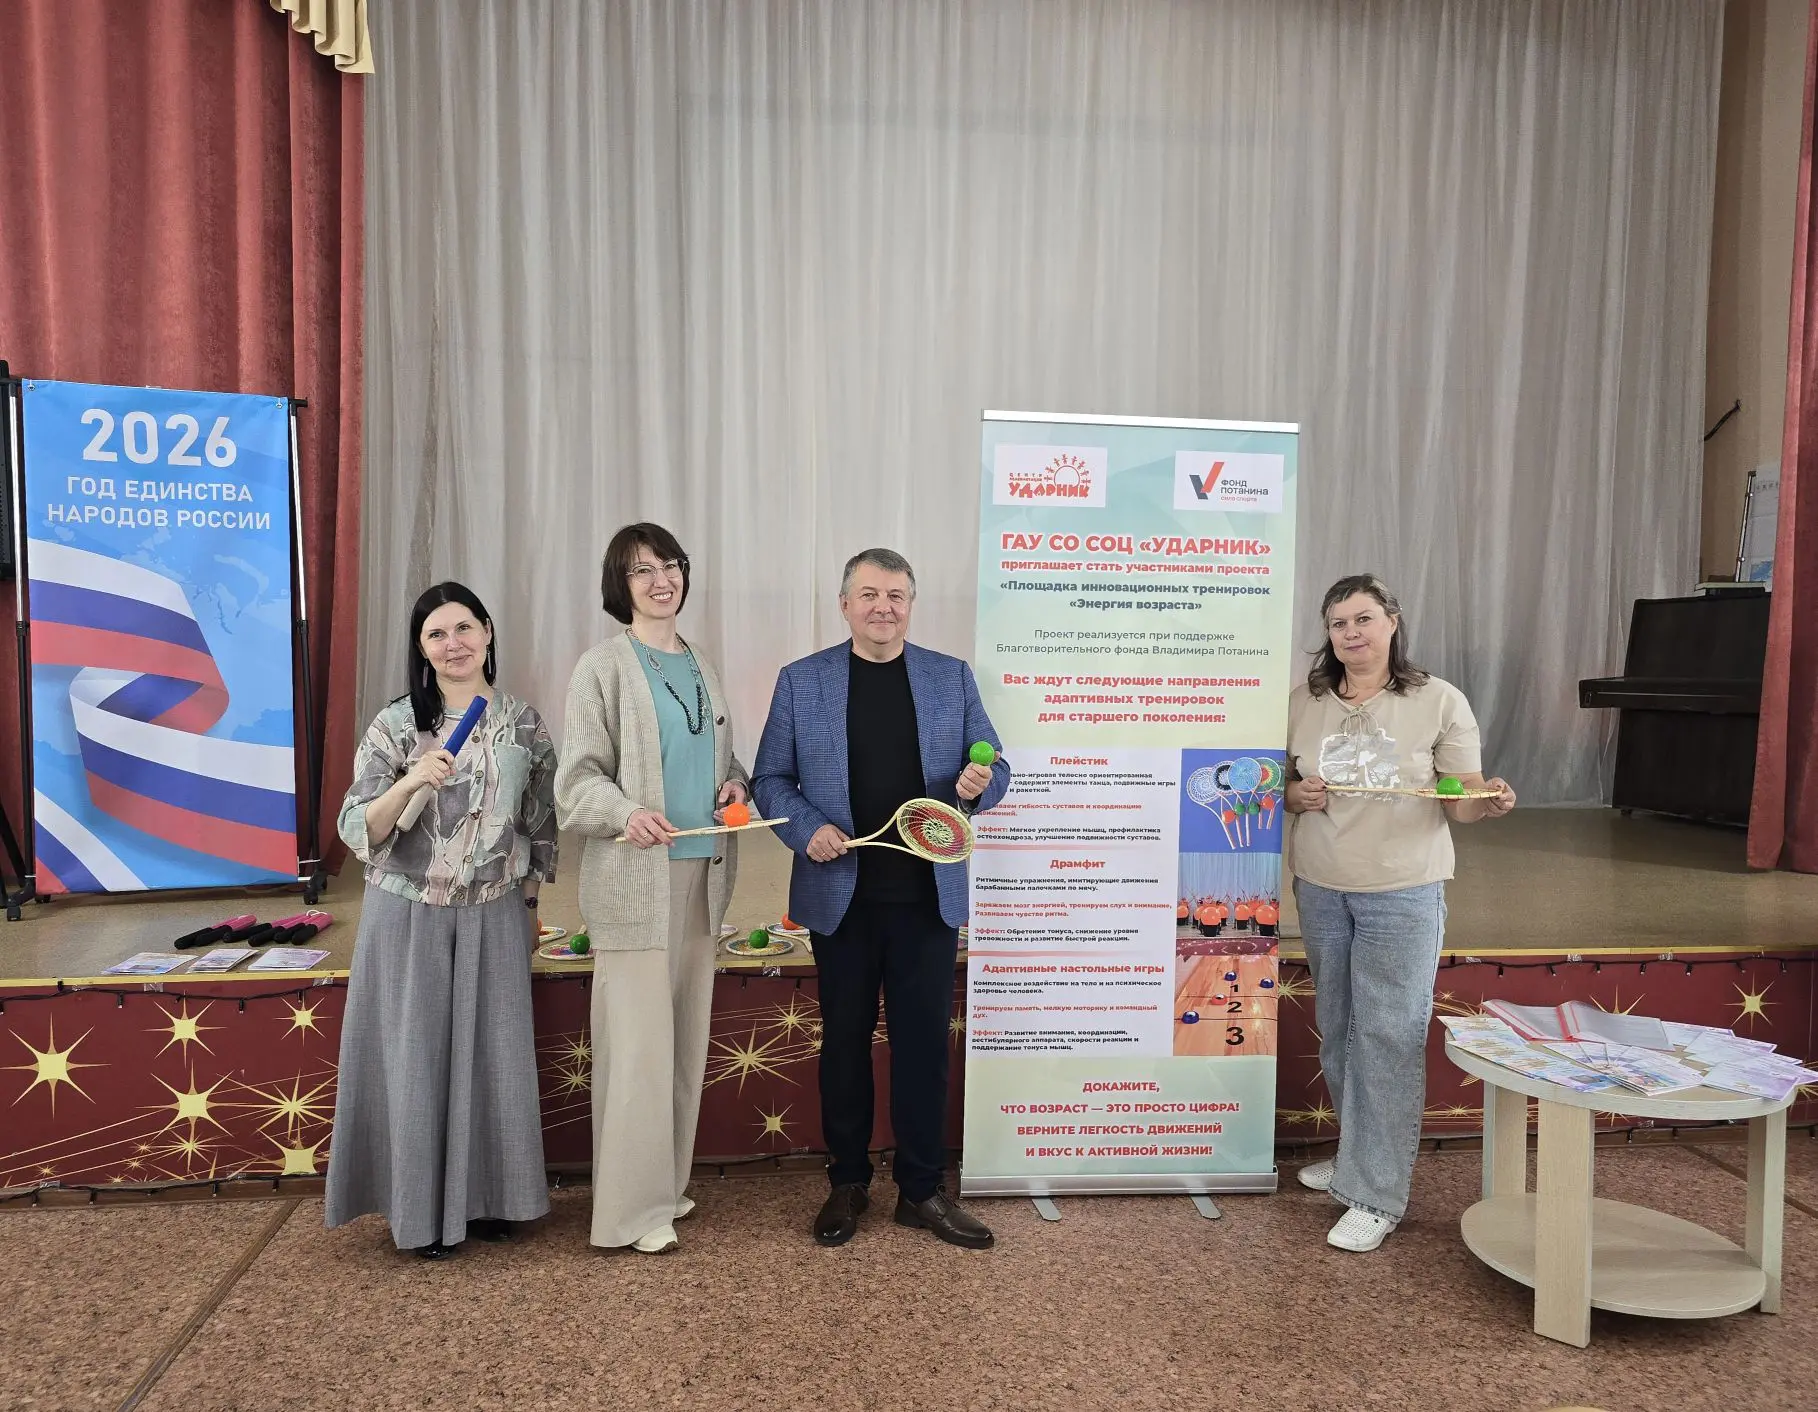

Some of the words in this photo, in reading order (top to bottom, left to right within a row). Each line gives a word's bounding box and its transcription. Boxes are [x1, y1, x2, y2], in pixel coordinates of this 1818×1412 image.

[80, 408, 237, 467] 2026
[68, 476, 116, 499] ГОД
[125, 480, 253, 502] ЕДИНСТВА
[1008, 482, 1090, 498] УДАРНИК
[48, 503, 168, 528] НАРОДОВ
[177, 510, 270, 530] РОССИИ
[1002, 533, 1043, 551] ГАУ
[1049, 534, 1080, 551] СО
[1085, 535, 1133, 555] СОЦ
[1139, 537, 1271, 556] «УДАРНИК»
[1001, 560, 1082, 571] приглашает
[1086, 562, 1122, 572] стать
[1126, 562, 1213, 573] участниками
[1217, 565, 1270, 576] проекта
[1000, 580, 1078, 592] «Площадка
[1081, 582, 1189, 593] инновационных
[1192, 585, 1270, 596] тренировок
[1070, 598, 1132, 610] «Энергия
[1136, 601, 1202, 611] возраста»
[1034, 630, 1074, 640] Проект
[1077, 631, 1146, 641] реализуется
[1148, 632, 1170, 642] при
[1174, 633, 1234, 642] поддержке
[996, 644, 1111, 654] Благотворительного
[1114, 644, 1149, 655] фонда
[1152, 646, 1214, 656] Владимира
[1218, 646, 1270, 656] Потанина
[1004, 674, 1029, 684] Вас
[1034, 676, 1072, 687] ждут
[1076, 676, 1163, 687] следующие
[1168, 677, 1260, 688] направления
[1044, 694, 1133, 704] адаптивных
[1138, 696, 1224, 706] тренировок
[1038, 713, 1065, 722] для
[1069, 713, 1138, 723] старшего
[1142, 714, 1226, 723] поколения:
[1050, 756, 1108, 766] Плейстик
[1088, 772, 1153, 780] ориентированная
[1016, 786, 1052, 794] ракеткой.
[1157, 780, 1176, 788] игры
[1009, 826, 1036, 834] Мягкое
[1034, 834, 1075, 842] улучшение
[1050, 860, 1105, 869] Драмфит
[976, 876, 1018, 884] Ритмичные
[976, 884, 1026, 892] барабанными
[982, 964, 1057, 974] Адаптивные
[1060, 964, 1132, 974] настольные
[1134, 965, 1164, 974] игры
[1230, 984, 1239, 993] 1
[1227, 1002, 1242, 1012] 2
[1226, 1027, 1244, 1045] 3
[972, 1044, 1022, 1052] поддержание
[1082, 1082, 1160, 1092] ДОКАЖИТЕ,
[1000, 1104, 1026, 1114] ЧТО
[1030, 1104, 1088, 1113] ВОЗРАСТ
[1106, 1104, 1130, 1112] ЭТО
[1134, 1104, 1186, 1112] ПРОСТО
[1190, 1102, 1240, 1113] ЦИФРА!
[1018, 1126, 1075, 1135] ВЕРНИТЕ
[1078, 1125, 1144, 1134] ЛЕГКОСТЬ
[1147, 1122, 1222, 1135] ДВИЖЕНИЙ
[1025, 1147, 1035, 1156] И
[1038, 1147, 1072, 1156] ВКУС
[1075, 1146, 1084, 1156] К
[1088, 1144, 1158, 1156] АКТИВНОЙ
[1162, 1146, 1212, 1155] ЖИЗНИ!
